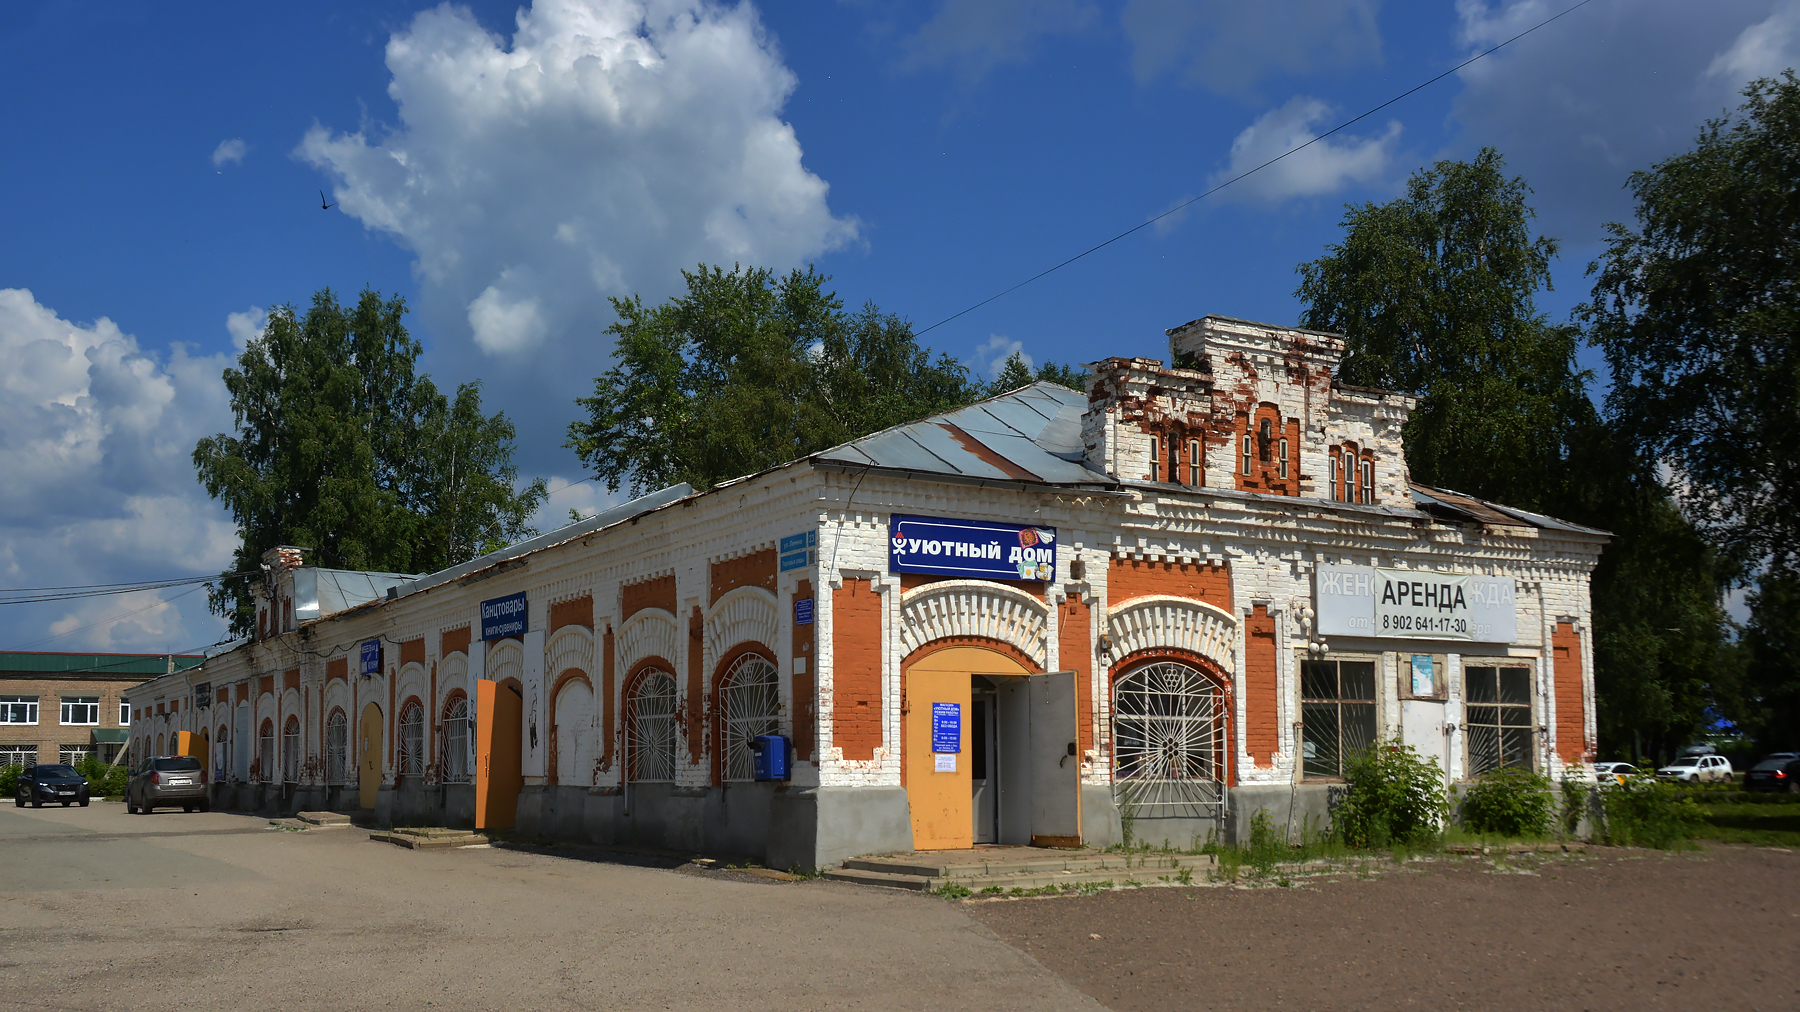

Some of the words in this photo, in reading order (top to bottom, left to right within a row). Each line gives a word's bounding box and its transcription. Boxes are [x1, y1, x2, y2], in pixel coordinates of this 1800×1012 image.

[809, 534, 814, 543] 23
[908, 538, 1001, 560] УЮТНЫЙ
[1008, 546, 1052, 564] ДОМ
[1382, 580, 1467, 613] АРЕНДА
[482, 598, 524, 619] Канцтовары
[1383, 614, 1389, 629] 8
[1393, 615, 1412, 630] 902
[1415, 616, 1466, 633] 641-17-30
